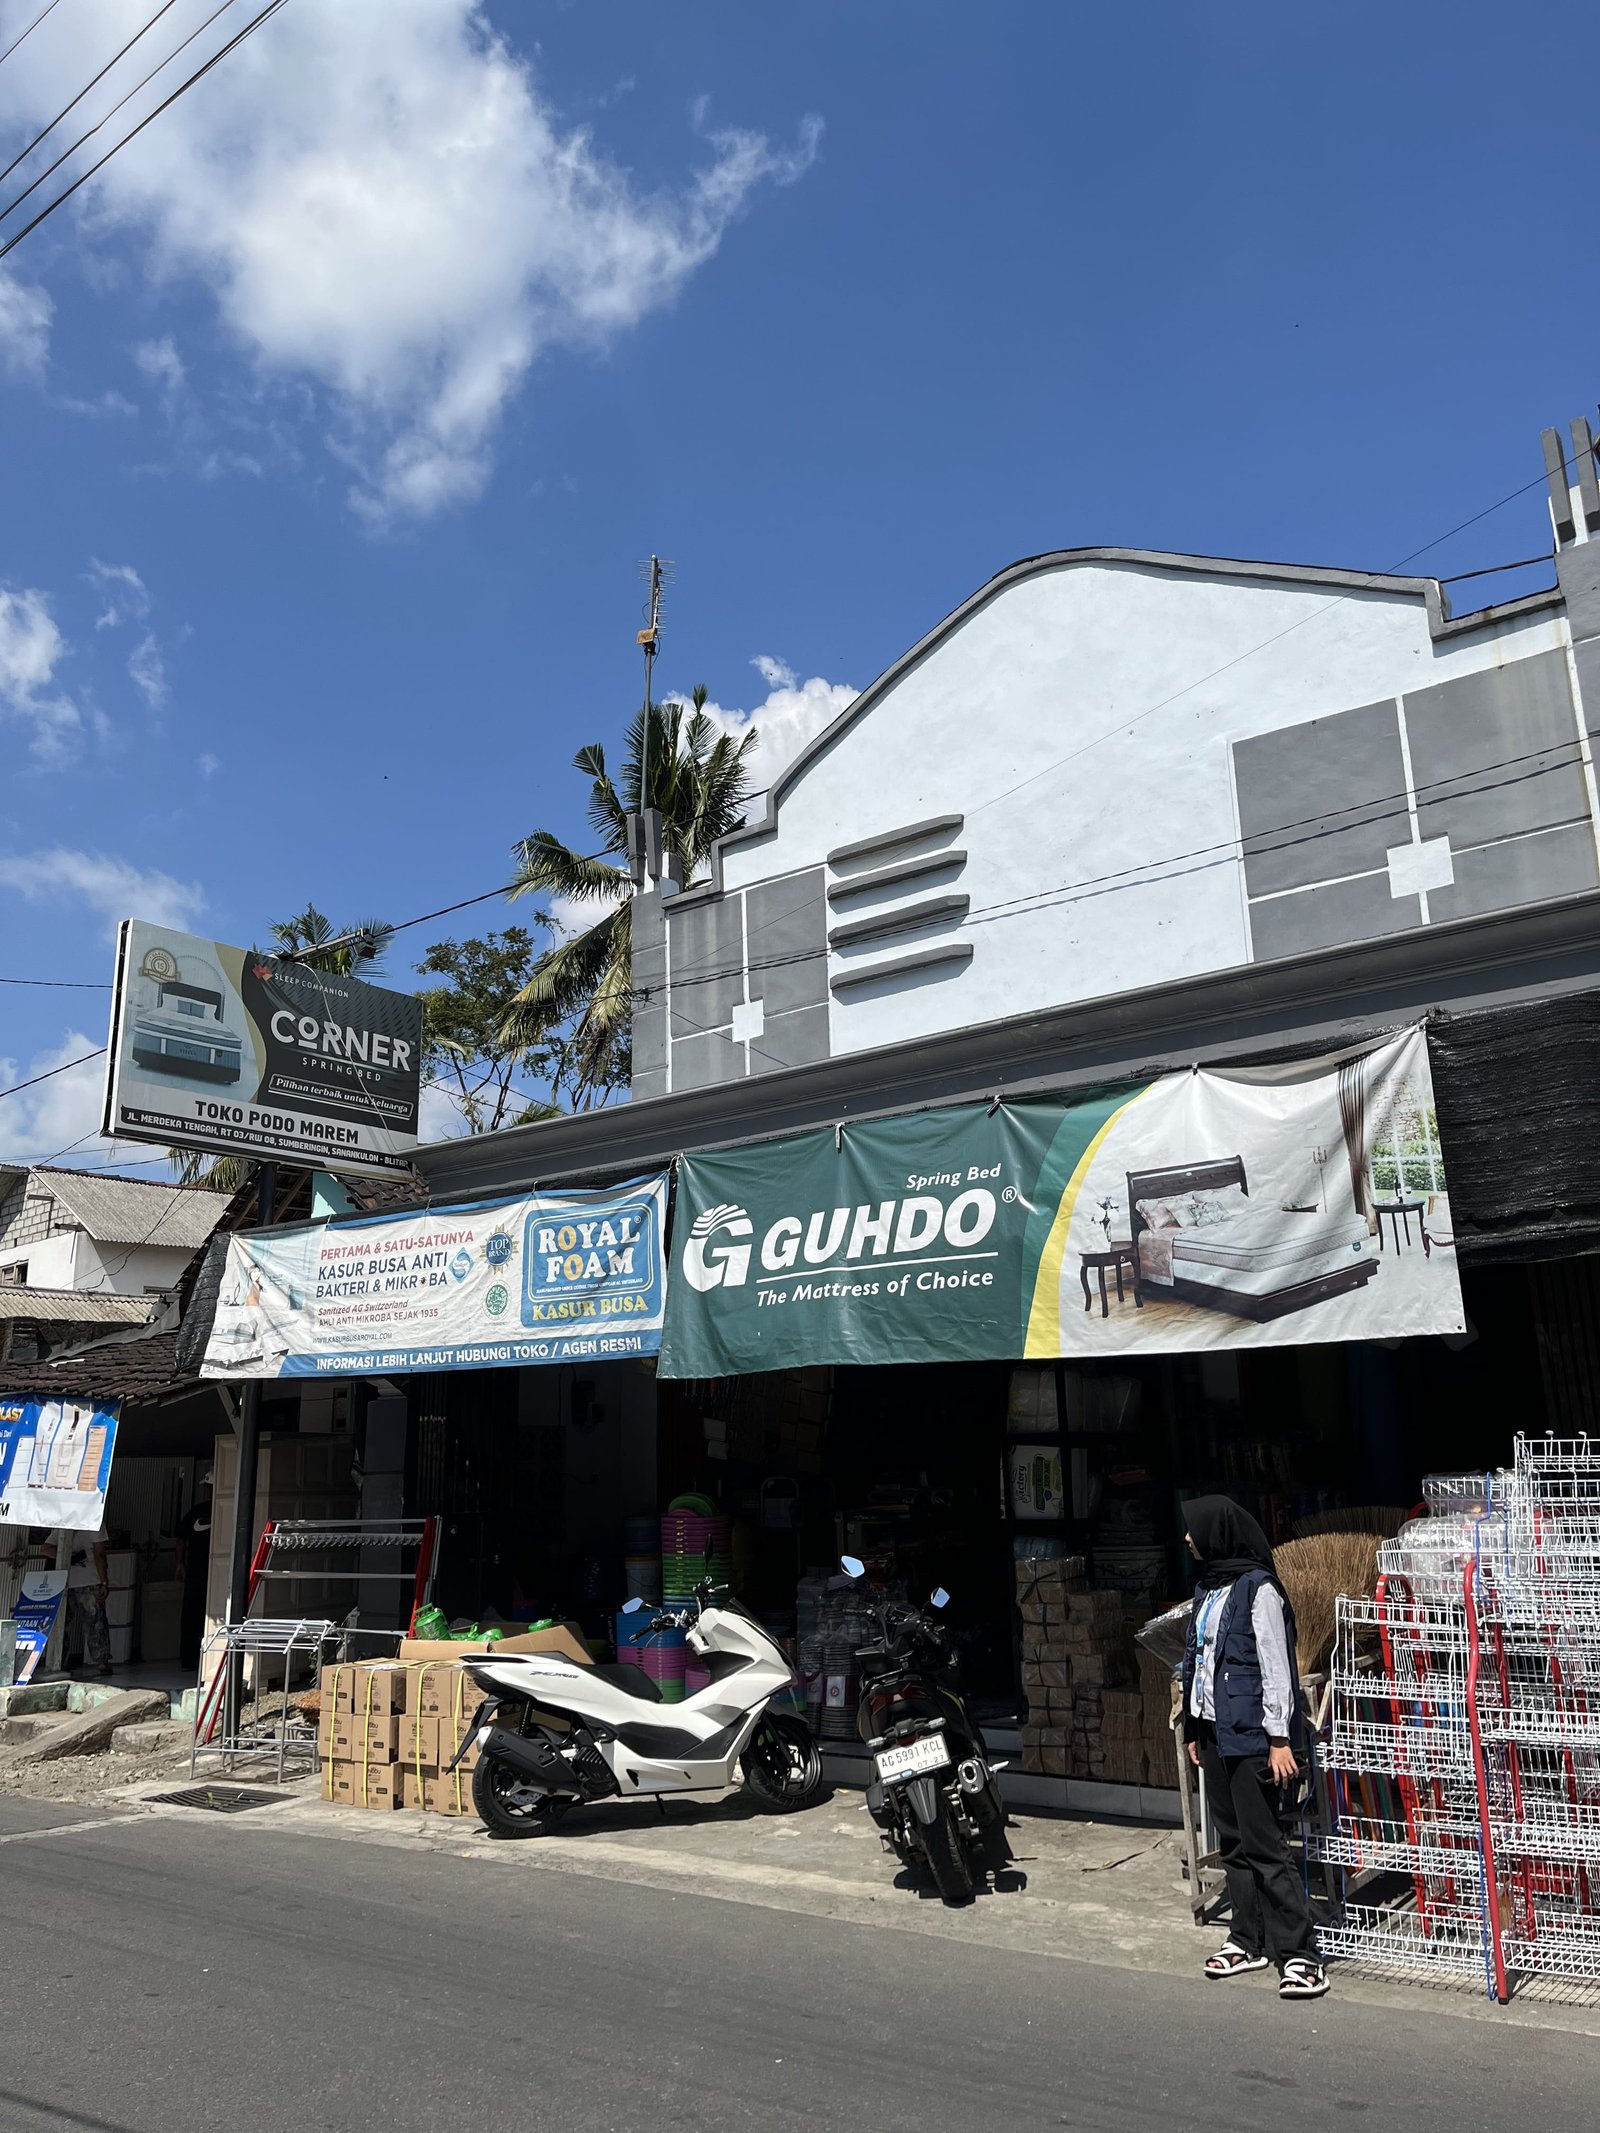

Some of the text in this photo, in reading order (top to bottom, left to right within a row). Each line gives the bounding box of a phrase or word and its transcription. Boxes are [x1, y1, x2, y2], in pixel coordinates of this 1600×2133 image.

[274, 973, 349, 998] SLEEP COMPANION
[270, 1010, 411, 1072] CORNER
[302, 1057, 381, 1082] SPRING BED
[276, 1078, 408, 1113] Pilihan terbaik untuk keluarga
[195, 1100, 359, 1144] TOKO PODO MAREM
[127, 1112, 139, 1121] JL.
[141, 1114, 182, 1129] MERDEKA
[184, 1121, 219, 1136] TENGAH,
[220, 1127, 232, 1137] RT
[233, 1131, 263, 1143] 03/RW
[264, 1136, 277, 1146] 08,
[278, 1138, 331, 1155] SUMBERINGIN,
[332, 1147, 379, 1162] SANANKULON
[906, 1162, 1002, 1191] Spring Bed
[488, 1238, 510, 1251] TOP
[538, 1217, 641, 1254] ROYAL
[760, 1188, 997, 1272] GUHDO
[321, 1231, 474, 1260] PERTAMA & SATU-SATUNYA
[488, 1247, 510, 1258] BRAND
[318, 1252, 448, 1281] KASUR BUSA ANTI
[546, 1247, 634, 1283] FOAM
[316, 1280, 369, 1298] BAKTERI
[373, 1279, 381, 1292] &
[757, 1269, 994, 1308] The Mattress of Choice
[318, 1299, 409, 1316] Sanitized AG Switzerland
[319, 1308, 438, 1327] AHLI ANTI MIKROBA SEJAK 1935
[532, 1295, 649, 1321] KASUR BUSA
[317, 1336, 642, 1370] INFORMASI LEBIH LANJUT HUBUNGI TOKO / AGEN RESMI
[895, 1746, 920, 1764] 5991
[922, 1740, 943, 1755] KCL
[917, 1754, 944, 1768] 07-27
